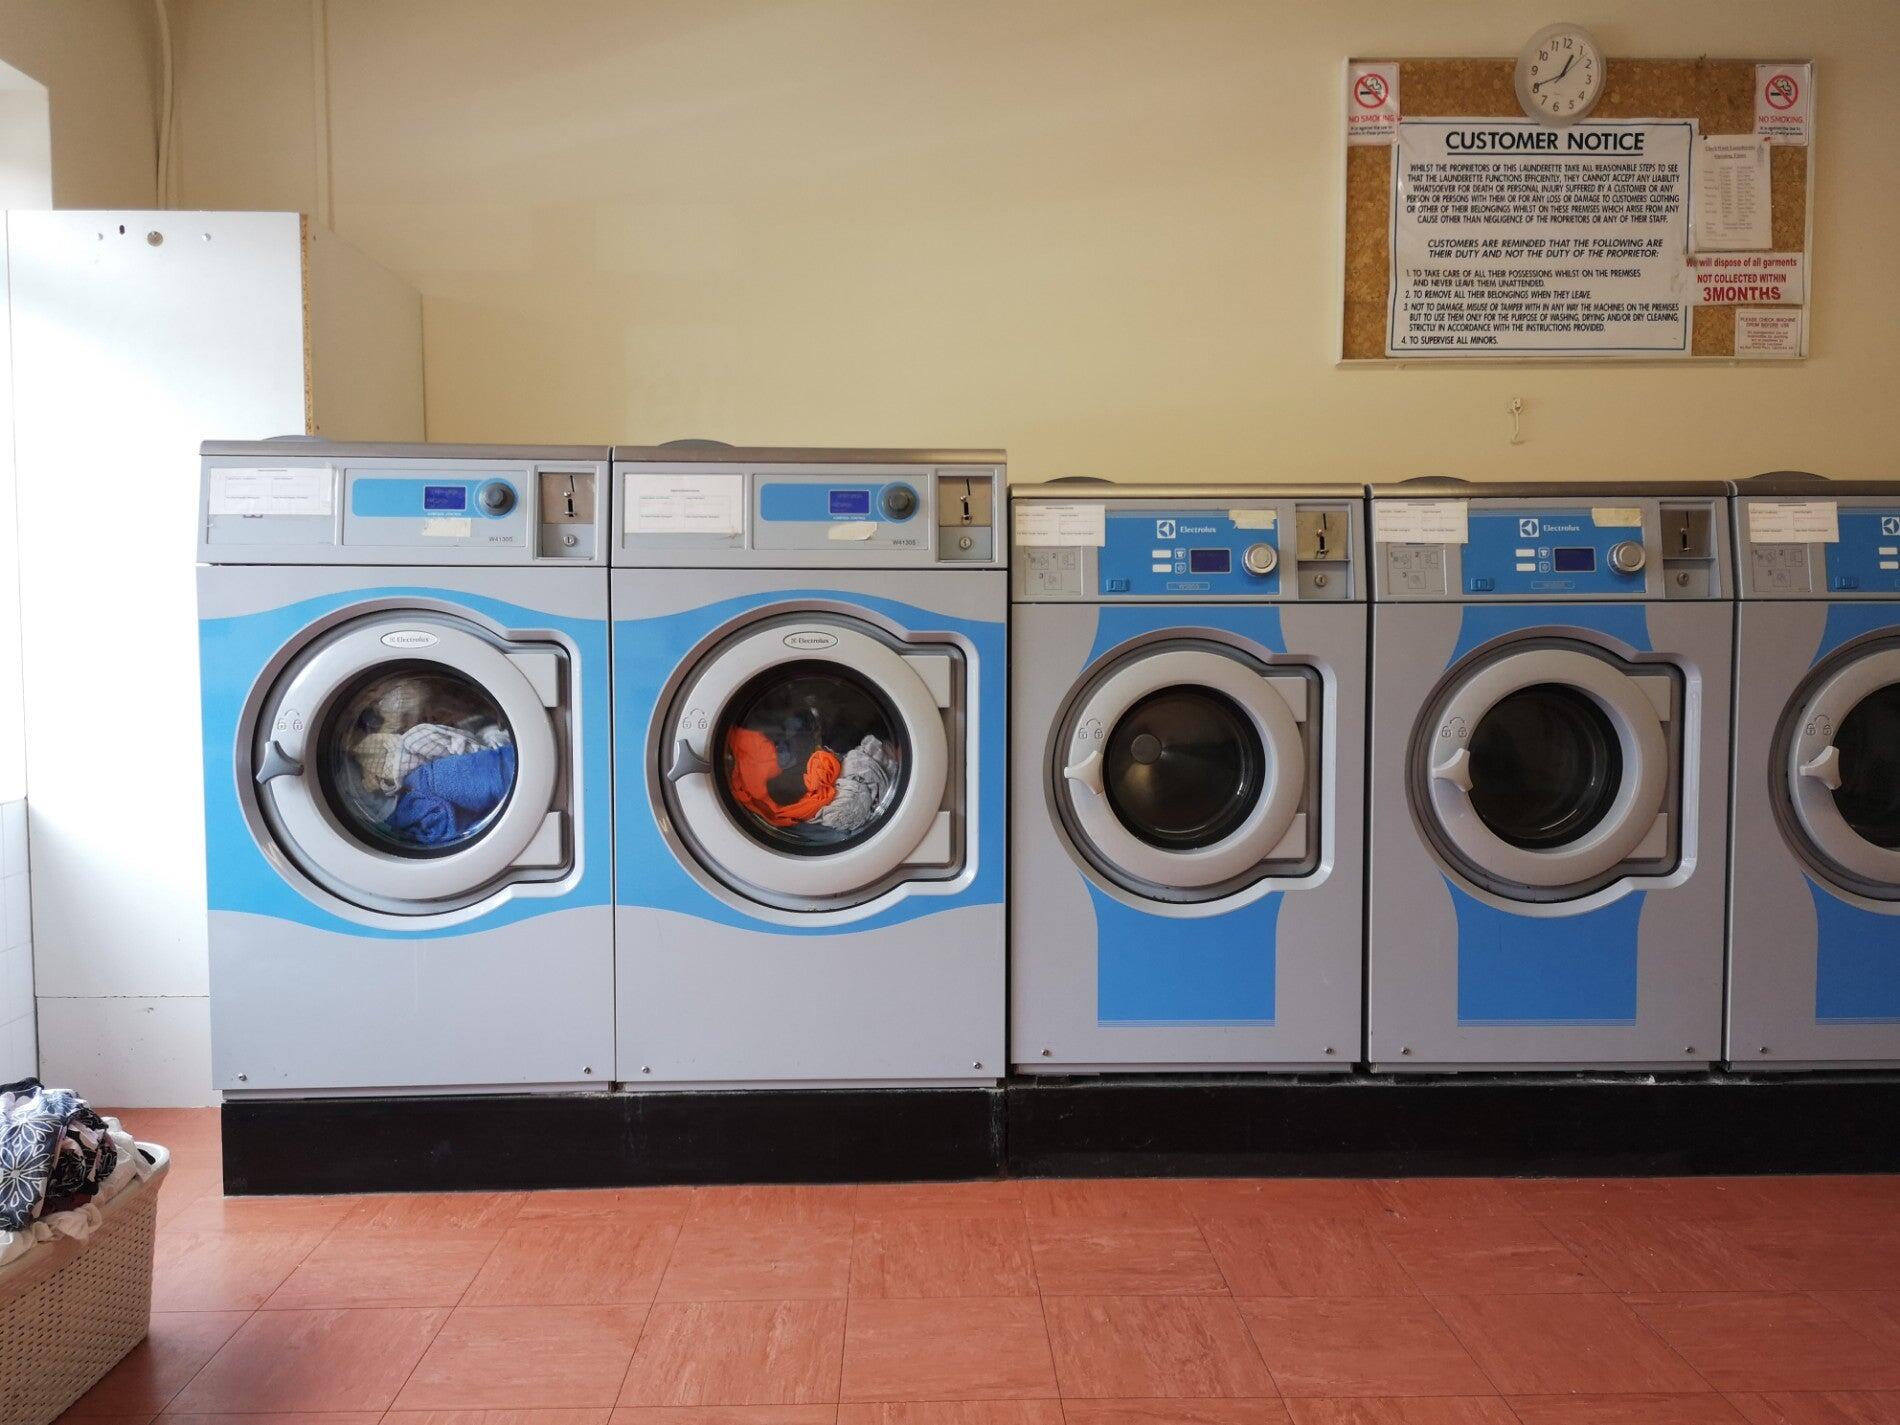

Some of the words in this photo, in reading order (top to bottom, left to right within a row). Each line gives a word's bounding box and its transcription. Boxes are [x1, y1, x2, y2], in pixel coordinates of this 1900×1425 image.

[1551, 41, 1559, 51] 11
[1564, 38, 1573, 49] 12
[1580, 46, 1583, 55] 1
[1540, 50, 1548, 61] 10
[1585, 59, 1592, 69] 2
[1531, 66, 1538, 76] 9
[1585, 75, 1591, 84] 3
[1532, 83, 1539, 93] 8
[1541, 95, 1548, 105] 7
[1578, 91, 1585, 101] 4
[1552, 102, 1559, 111] 6
[1569, 100, 1574, 109] 5
[1445, 132, 1559, 150] CUSTOMER
[1567, 132, 1645, 150] NOTICE
[1408, 174, 1423, 182] THAT
[1426, 174, 1437, 182] THE
[1440, 174, 1483, 182] LAUNDERETTE
[1486, 174, 1522, 182] FUNCTIONS
[1564, 174, 1580, 182] THEY
[1582, 174, 1610, 182] CANNOT
[1612, 174, 1635, 182] ACCEPT
[1637, 174, 1650, 182] ANY
[1652, 174, 1680, 182] LIABILITY
[1413, 185, 1455, 193] WHATSOEVER
[1458, 185, 1470, 193] FOR
[1473, 185, 1493, 193] DEATH
[1507, 185, 1538, 193] PERSONAL
[1542, 185, 1564, 193] INJURY
[1566, 185, 1595, 193] SUFFERED
[1614, 185, 1646, 193] CUSTOMER
[1660, 185, 1674, 193] ANY
[1407, 195, 1429, 203] PERSON
[1442, 195, 1468, 203] PERSONS
[1471, 195, 1487, 203] WITH
[1489, 195, 1505, 203] THEM
[1518, 195, 1530, 203] FOR
[1532, 195, 1544, 203] ANY
[1547, 195, 1560, 203] LOSS
[1574, 195, 1600, 203] DAMAGE
[1650, 195, 1680, 203] CLOTHING
[1418, 205, 1438, 213] OTHER
[1452, 205, 1468, 213] THEIR
[1471, 205, 1510, 213] BELONGINGS
[1513, 205, 1536, 213] WHILST
[1551, 205, 1569, 213] THESE
[1572, 205, 1600, 213] PREMISES
[1601, 205, 1623, 213] WHICH
[1626, 205, 1643, 213] ARISE
[1646, 205, 1662, 213] FROM
[1665, 205, 1680, 213] ANY
[1417, 215, 1438, 224] CAUSE
[1440, 215, 1460, 224] OTHER
[1463, 215, 1480, 224] THAN
[1483, 215, 1523, 224] NEGLIGENCE
[1536, 215, 1548, 224] THE
[1550, 215, 1590, 224] PROPRIETORS
[1603, 215, 1617, 224] ANY
[1631, 215, 1647, 224] THEIR
[1650, 215, 1669, 224] STAFF.
[1428, 239, 1479, 248] CUSTOMERS
[1482, 239, 1499, 248] ARE
[1501, 239, 1546, 248] REMINDED
[1550, 239, 1571, 248] THAT
[1574, 239, 1590, 248] THE
[1593, 239, 1643, 248] FOLLOWING
[1646, 239, 1664, 248] ARE
[1430, 249, 1452, 258] THEIR
[1455, 249, 1480, 258] DUTY
[1482, 249, 1502, 258] AND
[1505, 249, 1524, 258] NOT
[1527, 249, 1543, 258] THE
[1546, 249, 1570, 258] DUTY
[1572, 249, 1585, 258] OF
[1588, 249, 1604, 258] THE
[1606, 249, 1659, 258] PROPRIETOR:
[1686, 258, 1698, 267] We
[1699, 258, 1713, 267] will
[1714, 258, 1741, 268] dispose
[1744, 257, 1751, 267] of
[1753, 258, 1761, 267] all
[1763, 258, 1797, 268] garments
[1424, 269, 1440, 278] TAKE
[1442, 269, 1460, 278] CARE
[1474, 269, 1486, 278] ALL
[1488, 269, 1506, 278] THEIR
[1509, 269, 1553, 278] POSSESSIONS
[1554, 269, 1579, 278] WHILST
[1596, 269, 1608, 278] THE
[1610, 269, 1641, 278] PREMISES
[1413, 279, 1428, 287] AND
[1431, 279, 1452, 287] NEVER
[1455, 279, 1475, 287] LEAVE
[1477, 279, 1496, 287] THEM
[1697, 274, 1712, 283] NOT
[1715, 274, 1757, 283] COLLECTED
[1760, 274, 1786, 283] WITHIN
[1424, 290, 1452, 299] REMOVE
[1454, 290, 1465, 299] ALL
[1468, 290, 1485, 299] THEIR
[1487, 290, 1528, 299] BELONGINGS
[1531, 290, 1551, 299] WHEN
[1553, 290, 1570, 299] THEY
[1703, 287, 1781, 301] 3MONTHS
[1411, 303, 1424, 311] NOT
[1466, 303, 1488, 311] MISUSE
[1501, 303, 1523, 311] TAMPER
[1525, 303, 1540, 311] WITH
[1593, 303, 1625, 311] MACHINES
[1652, 303, 1679, 311] PREMISES
[1447, 313, 1464, 322] THEM
[1466, 313, 1481, 322] ONLY
[1511, 313, 1538, 322] PURPOSE
[1550, 313, 1580, 323] WASHING,
[1582, 313, 1605, 322] DRYING
[1646, 313, 1679, 323] CLEANING,
[1410, 323, 1436, 332] STRICTLY
[1447, 323, 1491, 332] ACCORDANCE
[1493, 323, 1509, 332] WITH
[1526, 323, 1571, 332] INSTRUCTIONS
[1420, 336, 1454, 345] SUPERVISE
[1456, 336, 1468, 345] ALL
[1470, 336, 1498, 345] MINORS.
